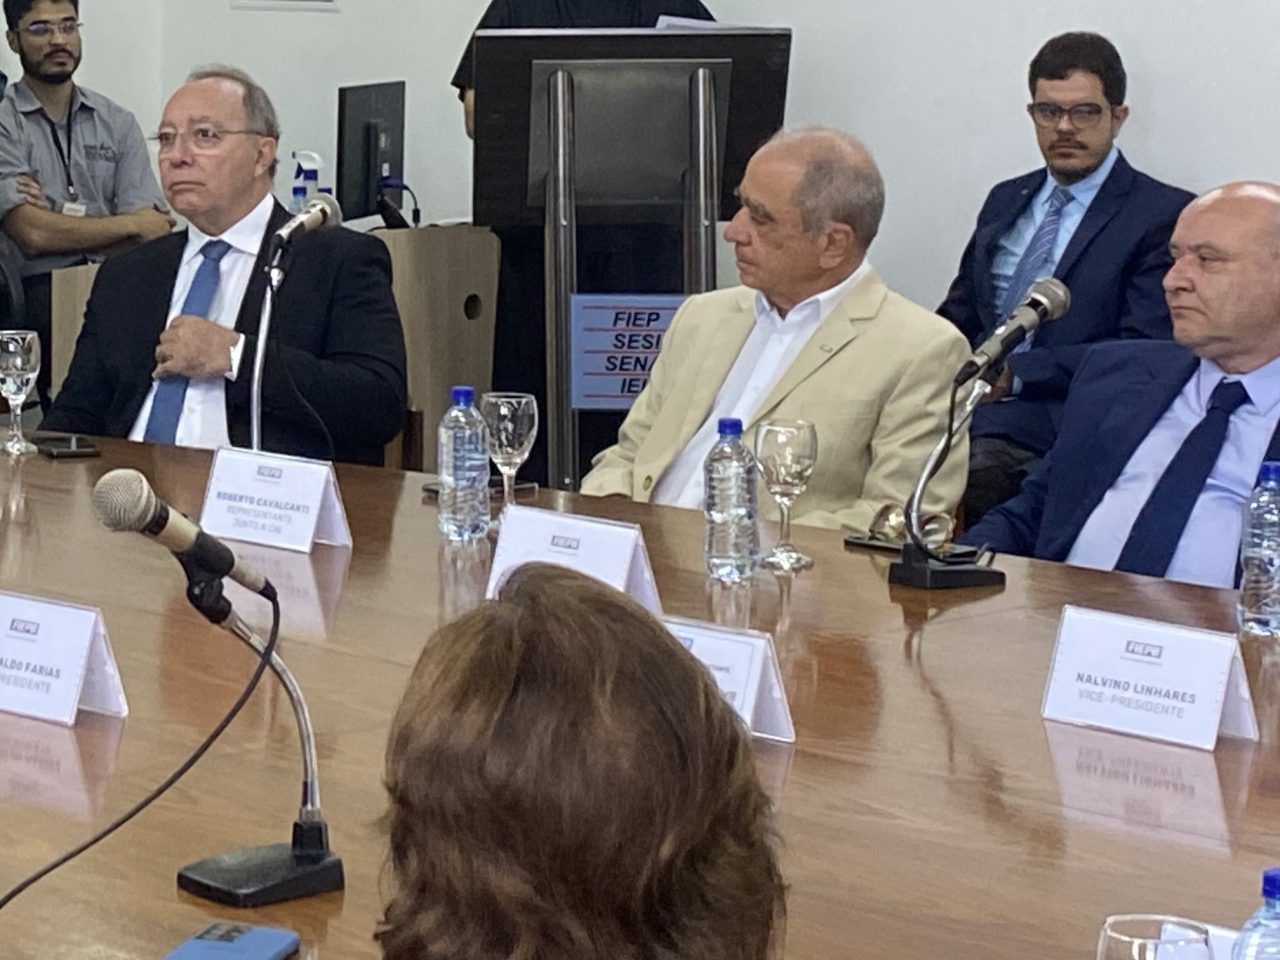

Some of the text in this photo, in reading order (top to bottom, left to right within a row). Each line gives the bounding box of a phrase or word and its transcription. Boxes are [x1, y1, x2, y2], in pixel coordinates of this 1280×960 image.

[613, 312, 660, 327] FIEP
[613, 333, 661, 350] SESI
[24, 661, 61, 679] FARIAS
[1075, 671, 1197, 705] NALVINO LINHARES
[1077, 687, 1185, 719] VICE-PRESIDENTE
